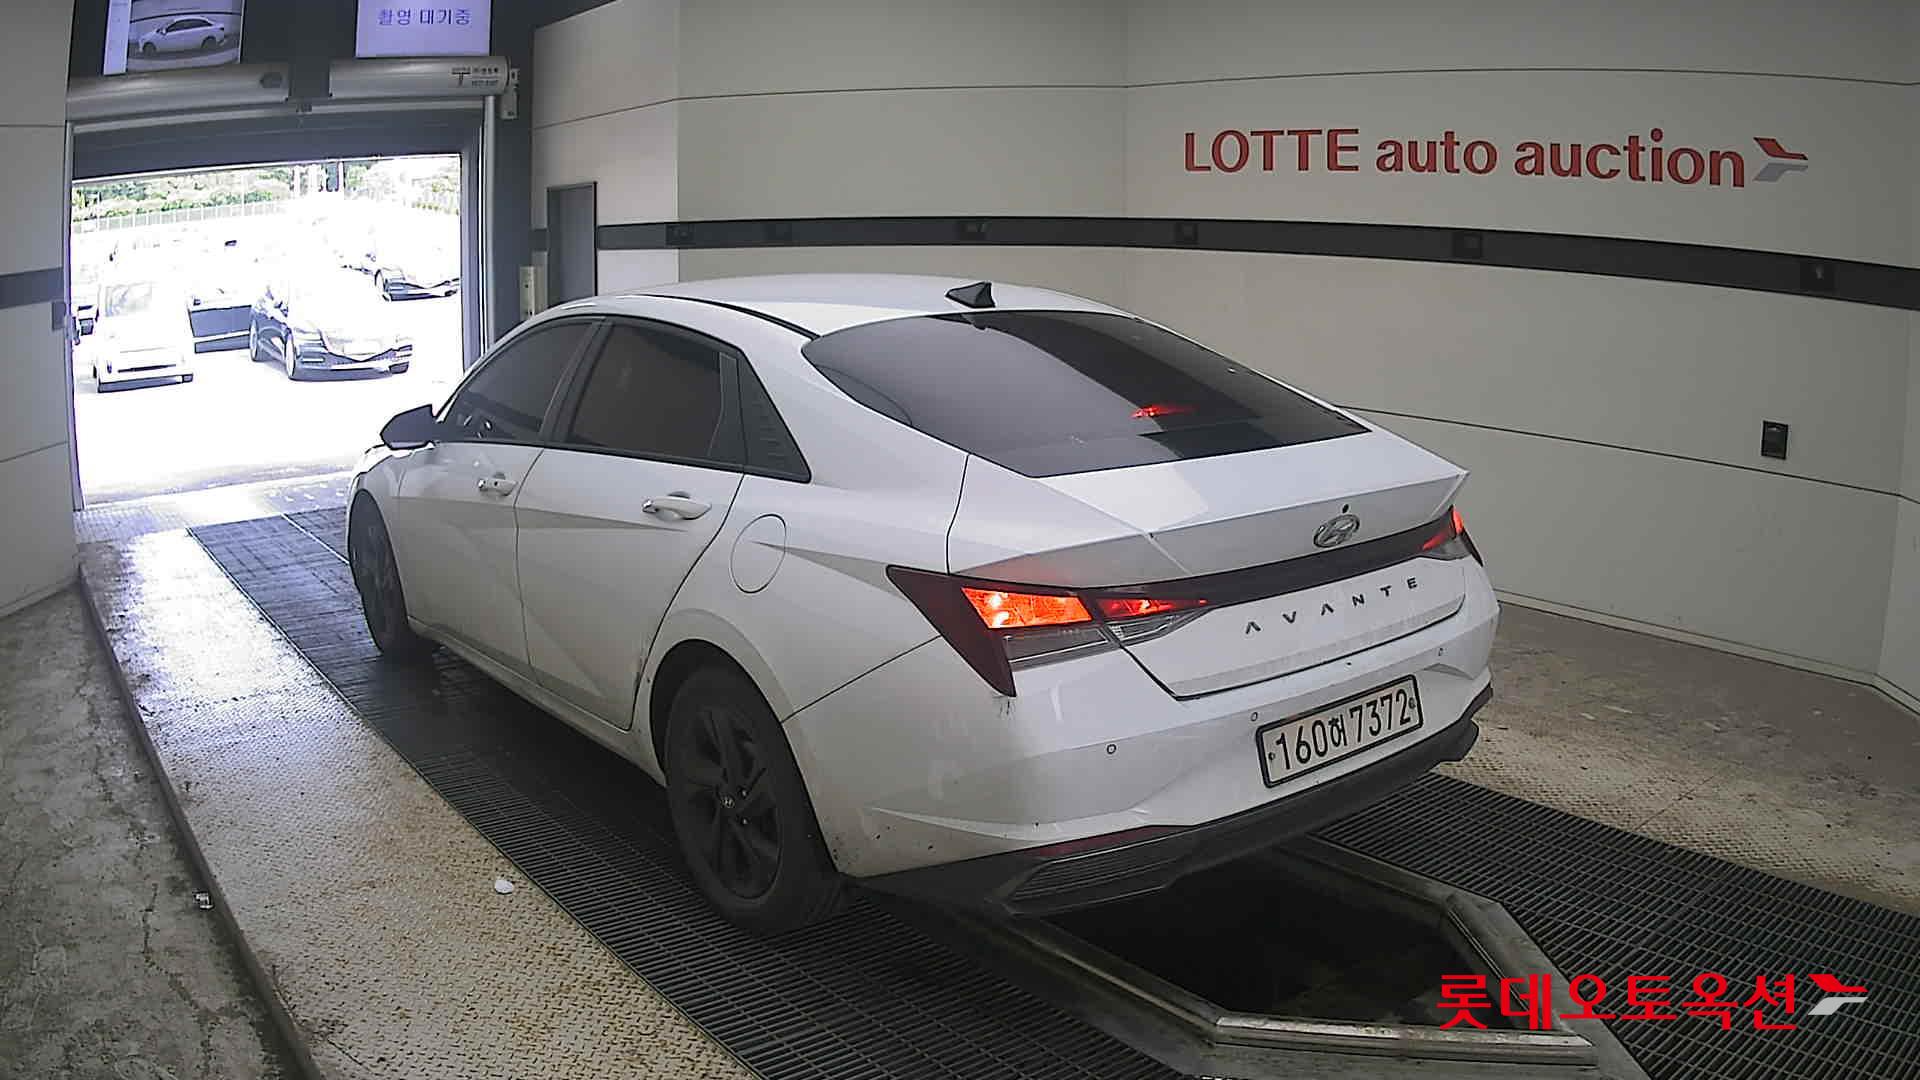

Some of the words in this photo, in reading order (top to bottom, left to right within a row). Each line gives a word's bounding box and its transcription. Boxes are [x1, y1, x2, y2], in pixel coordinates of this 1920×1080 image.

[378, 8, 411, 26] 촬영
[419, 8, 472, 26] 대기중
[1184, 128, 1360, 173] LOTTE
[1375, 130, 1499, 175] auto
[1514, 128, 1745, 188] auction
[1244, 576, 1419, 635] AVANTE
